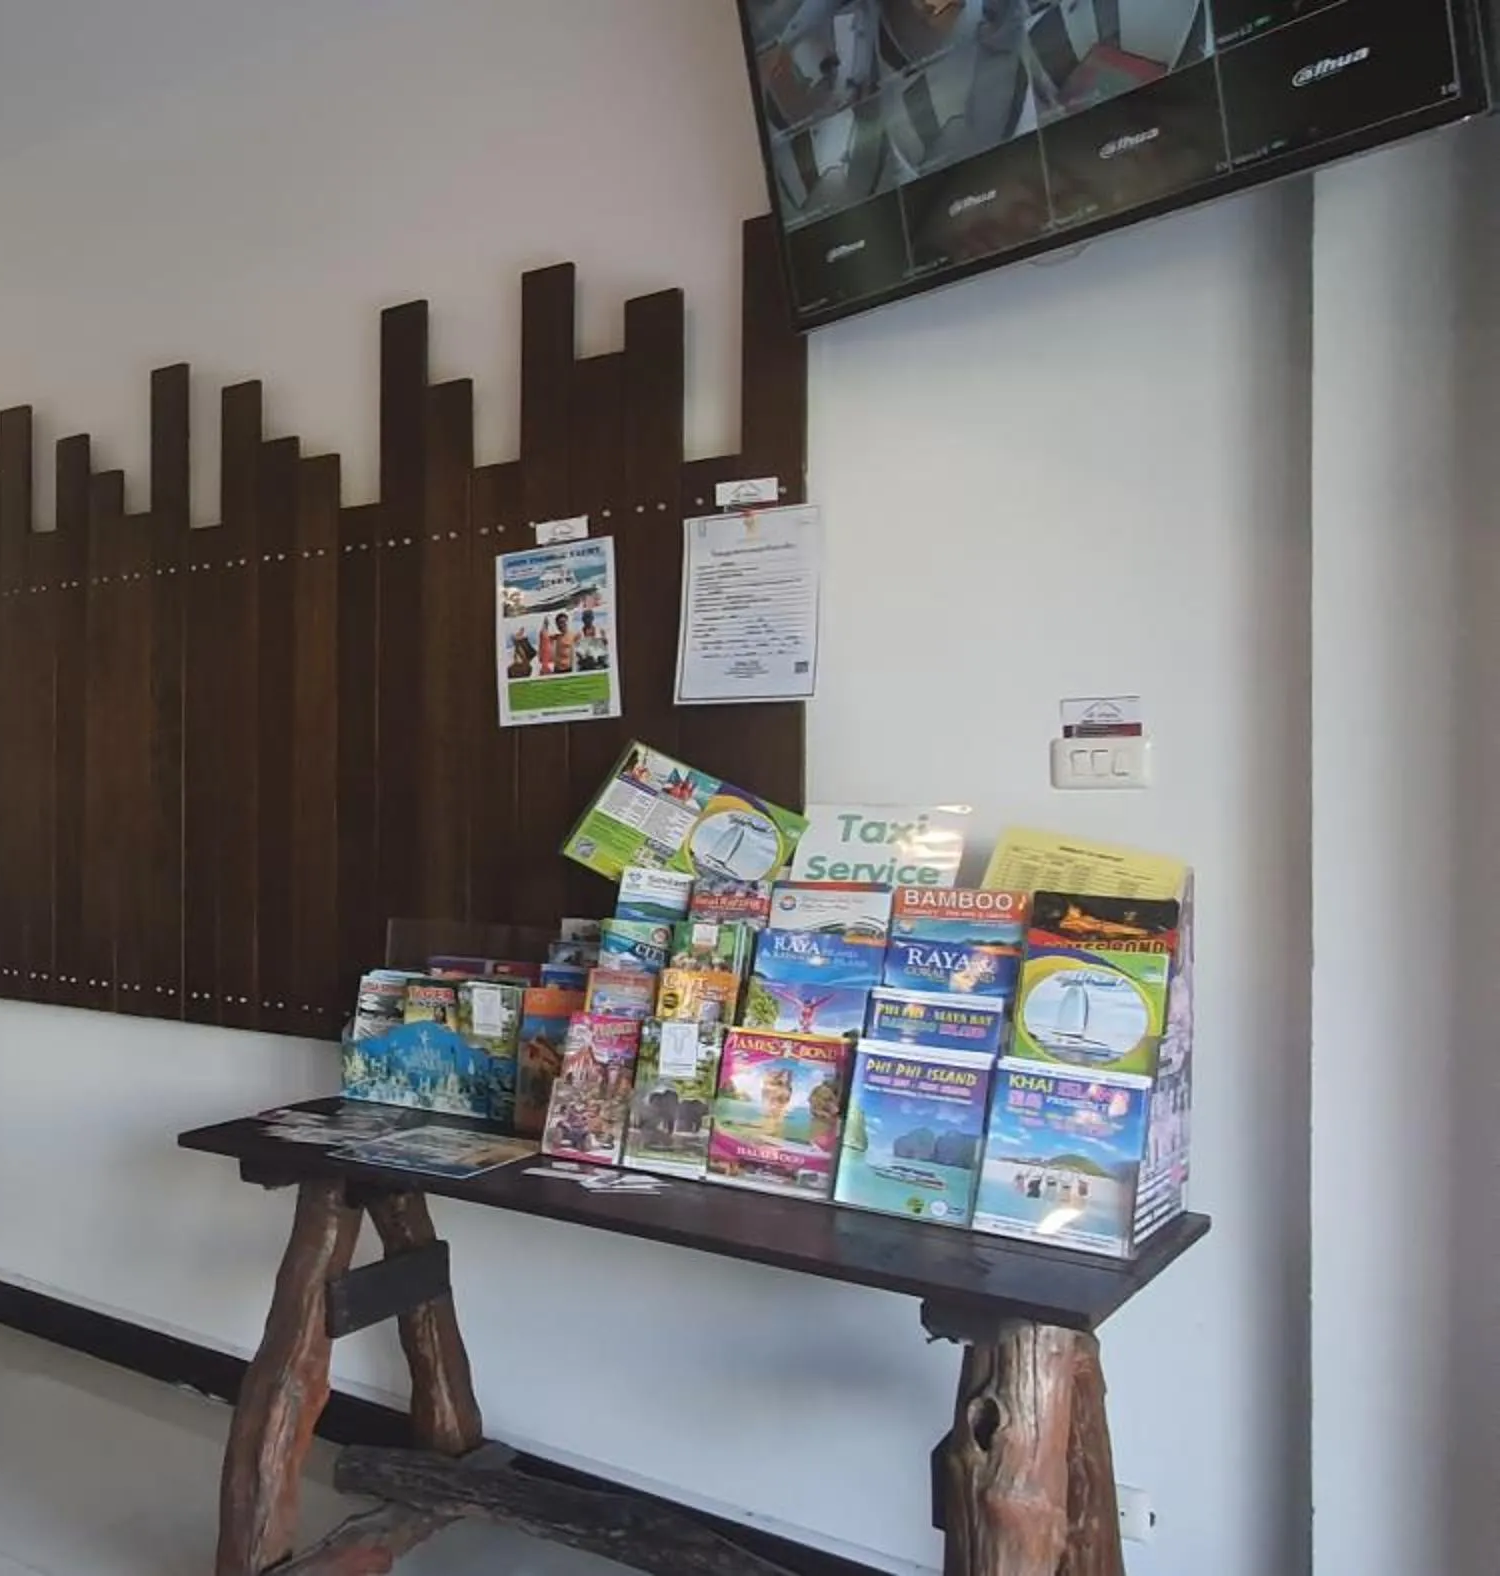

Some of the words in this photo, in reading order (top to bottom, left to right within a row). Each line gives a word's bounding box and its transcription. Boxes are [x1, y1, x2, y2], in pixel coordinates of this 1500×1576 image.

[837, 813, 931, 846] Taxi
[804, 856, 940, 886] Service
[904, 888, 1013, 912] BAMBOO
[773, 936, 821, 955] RAYA
[907, 948, 970, 971] RAYA
[866, 1058, 892, 1073] PHI
[896, 1063, 922, 1078] PHI
[927, 1068, 979, 1087] ISLAND
[1009, 1073, 1053, 1094] KHAI
